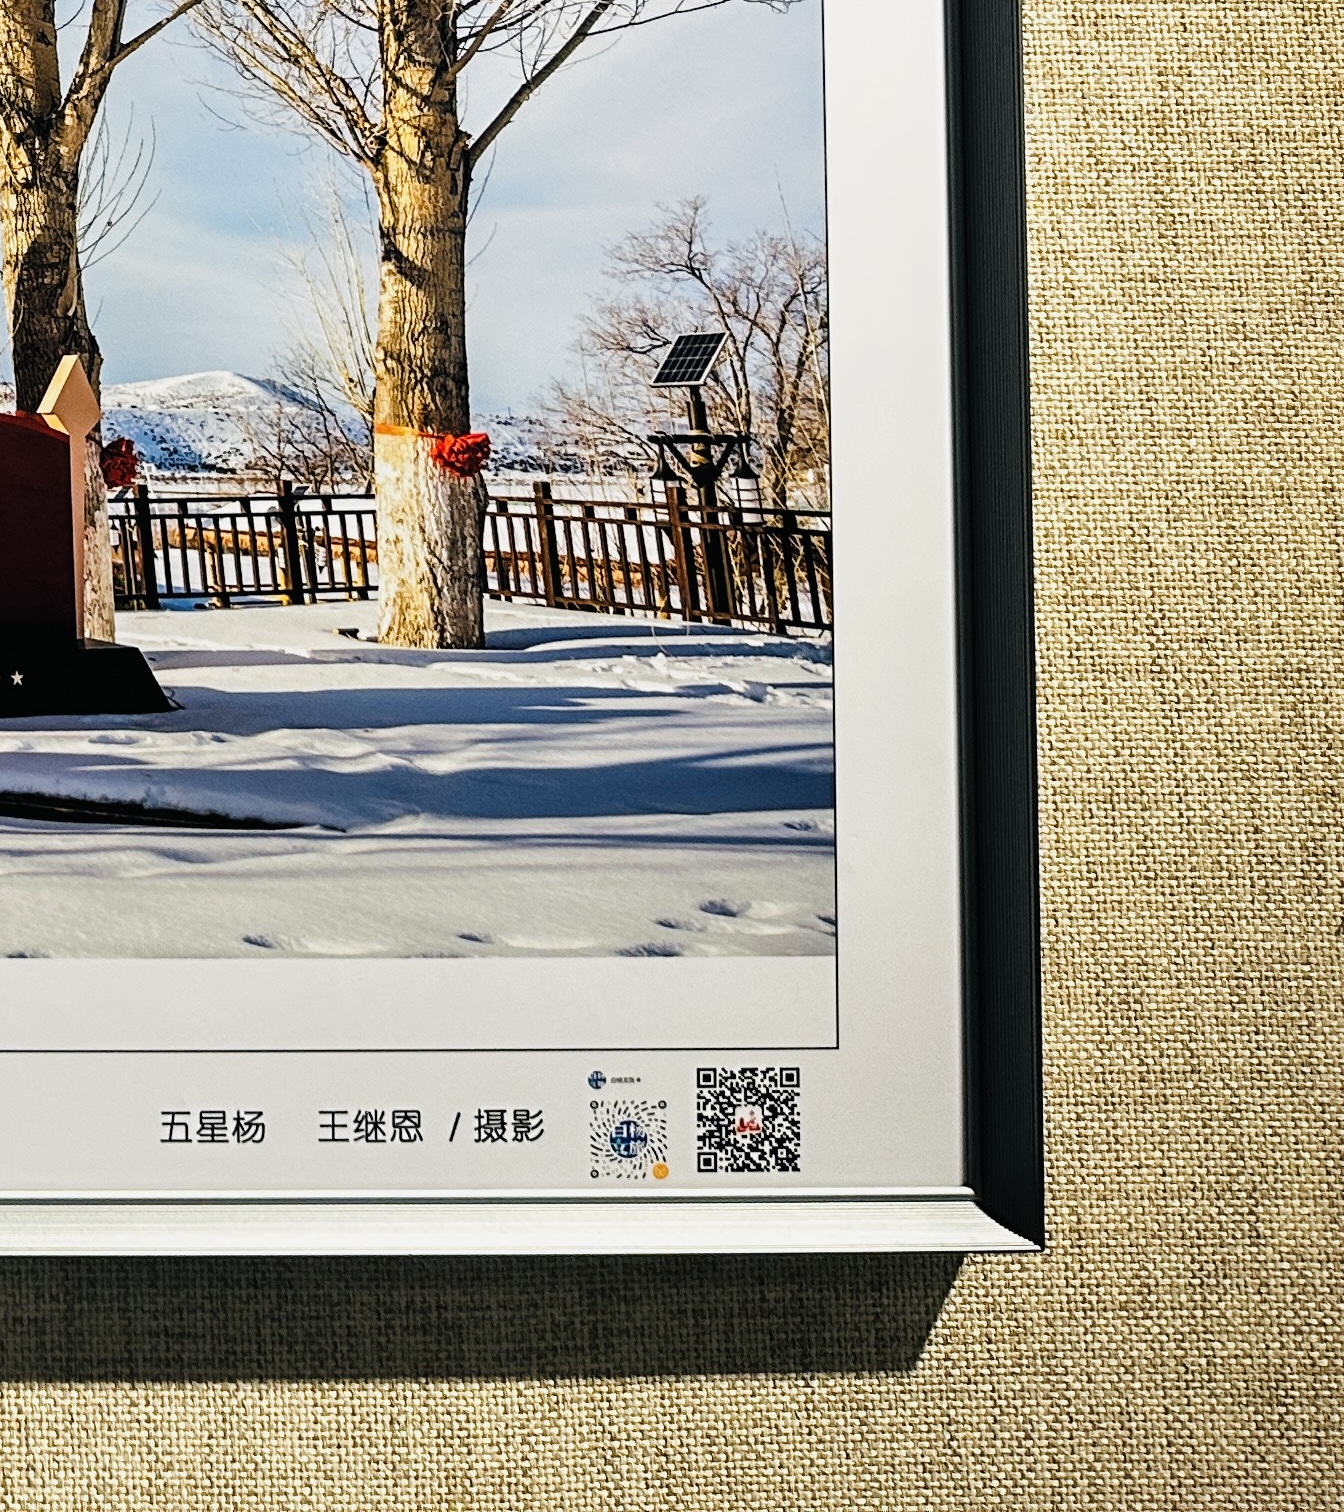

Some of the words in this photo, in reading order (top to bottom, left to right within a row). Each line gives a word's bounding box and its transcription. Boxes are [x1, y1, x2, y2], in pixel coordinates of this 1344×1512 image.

[160, 1110, 265, 1144] 五星杨
[318, 1109, 423, 1143] 王继恩
[474, 1108, 544, 1143] 摄影
